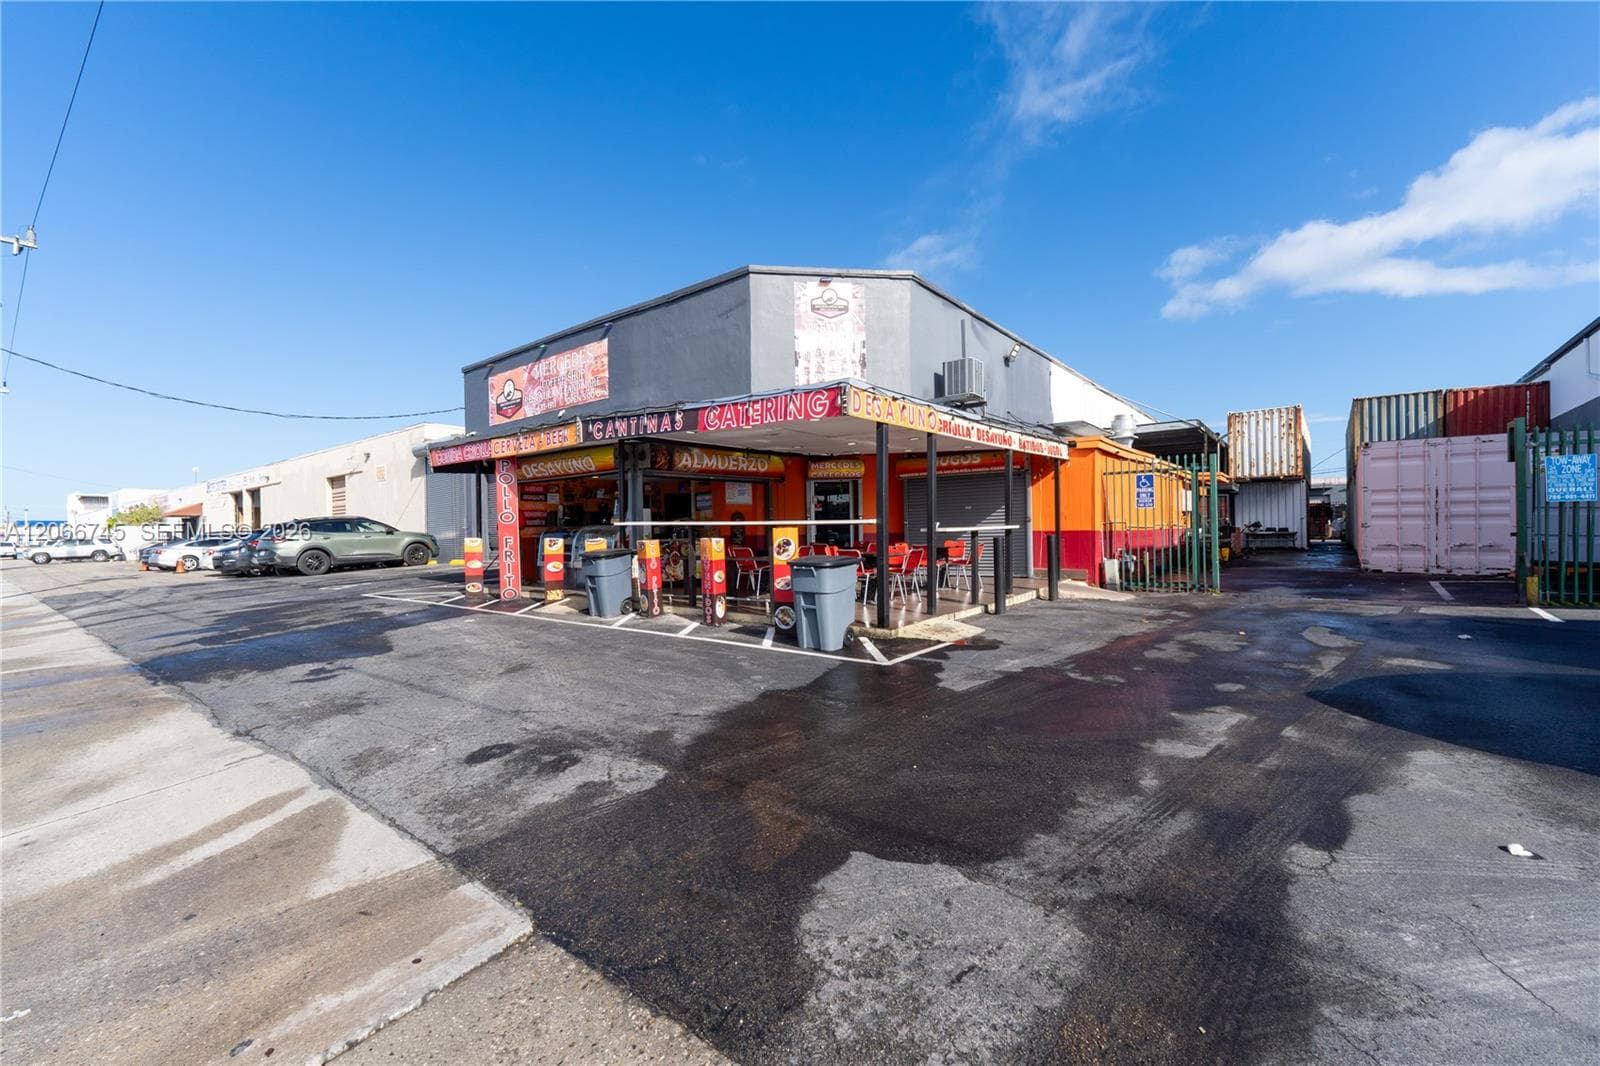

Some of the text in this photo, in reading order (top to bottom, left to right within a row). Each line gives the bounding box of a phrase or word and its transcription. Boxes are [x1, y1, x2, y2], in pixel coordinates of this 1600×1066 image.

[703, 389, 829, 431] CATERING
[852, 389, 938, 430] DESAYUNO
[592, 410, 685, 440] CANTINAS
[522, 455, 596, 479] DESAYUNO
[679, 453, 769, 472] ALMUERZO
[1551, 455, 1591, 465] TOW-AWAY
[1561, 464, 1582, 474] ZONE
[498, 459, 518, 600] POLLO FRITO
